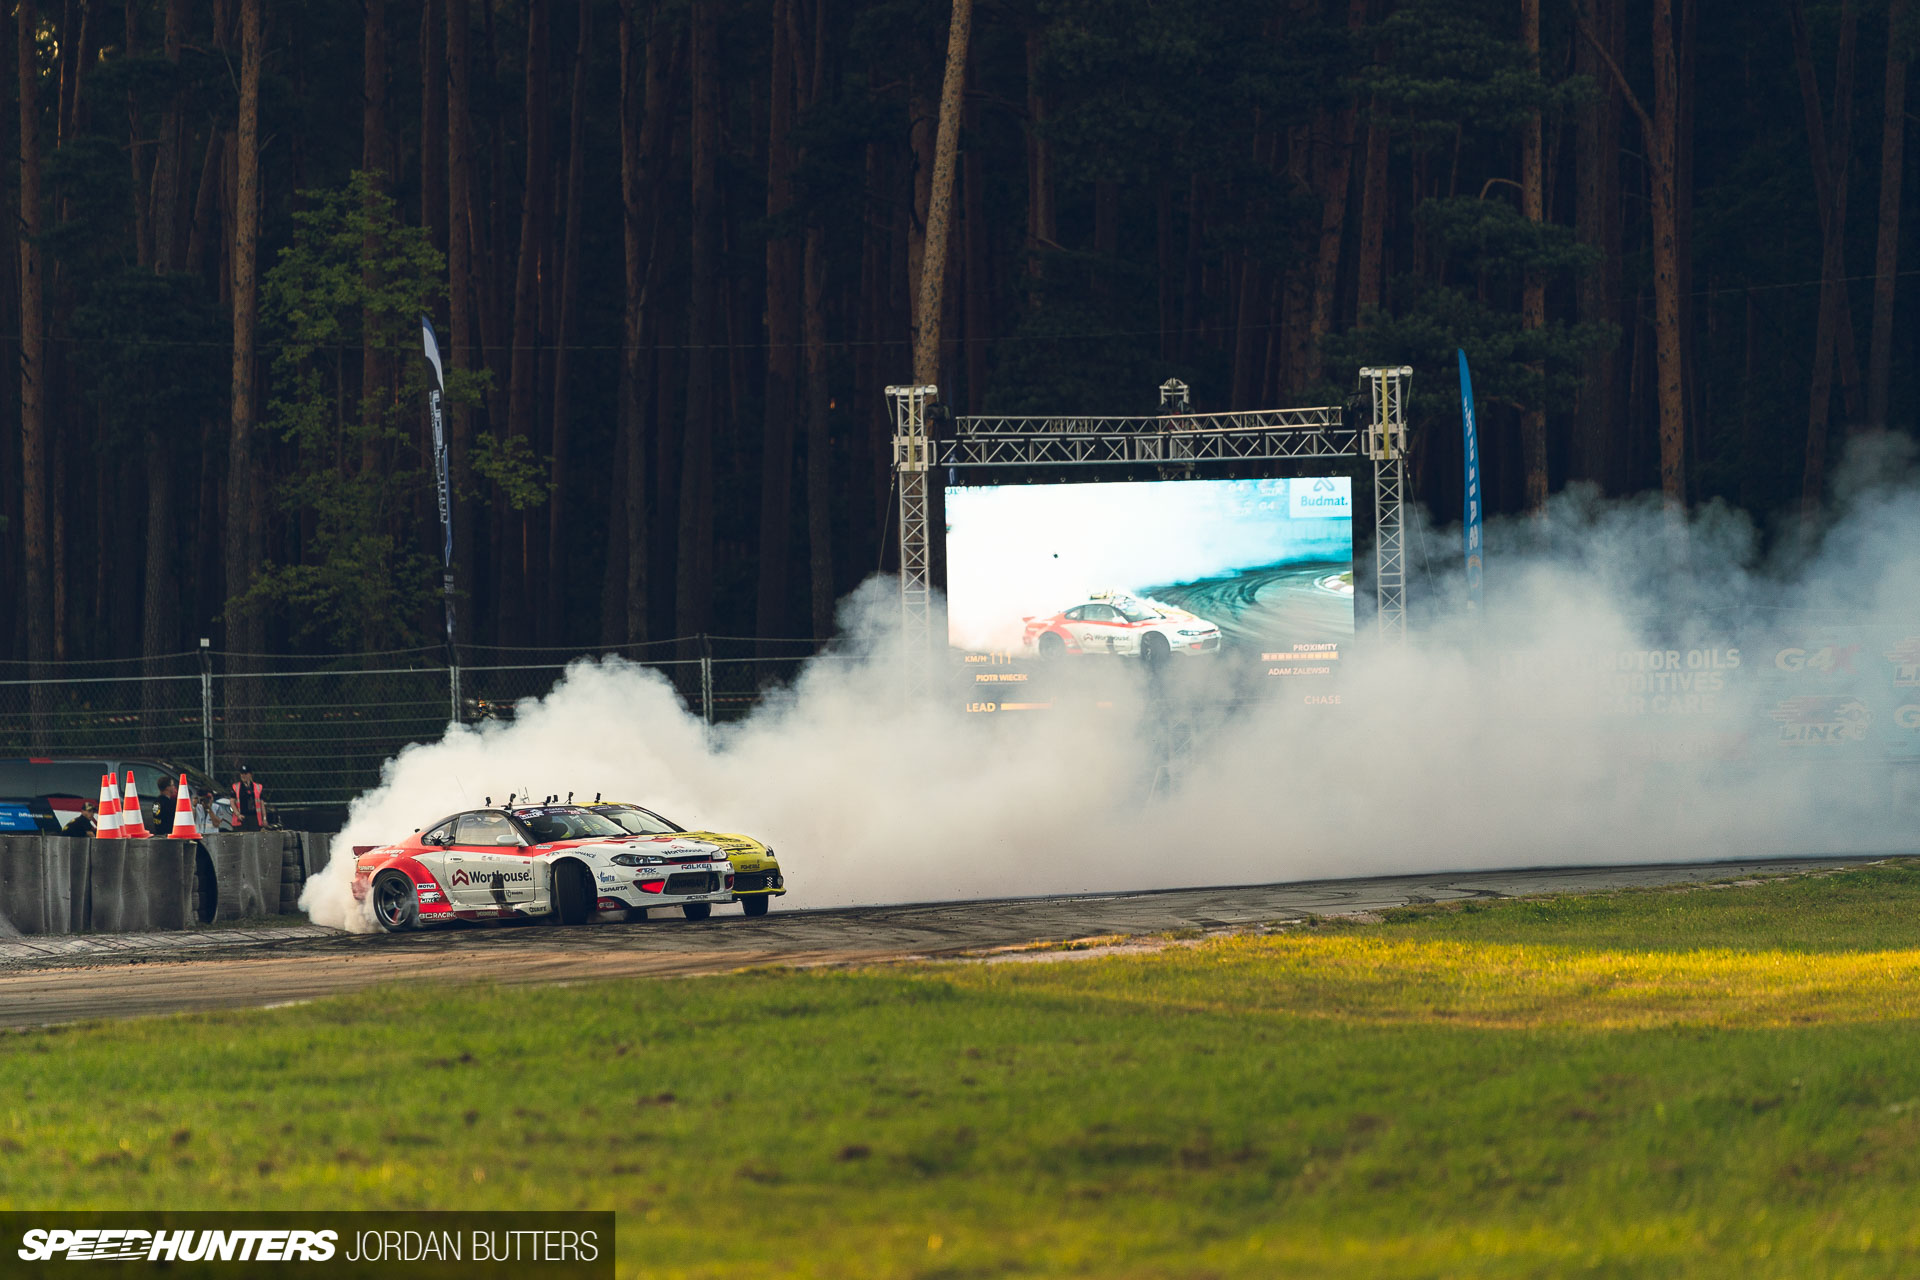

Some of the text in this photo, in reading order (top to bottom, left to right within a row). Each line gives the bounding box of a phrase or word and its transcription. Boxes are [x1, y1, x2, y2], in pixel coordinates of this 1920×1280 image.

[1293, 643, 1337, 652] PROXIMITY
[964, 652, 1011, 664] KM/H 111
[1687, 649, 1740, 669] OILS
[1268, 667, 1291, 675] ADAM
[975, 674, 998, 682] PIOTR
[1303, 695, 1341, 705] CHASE
[966, 702, 996, 712] LEAD
